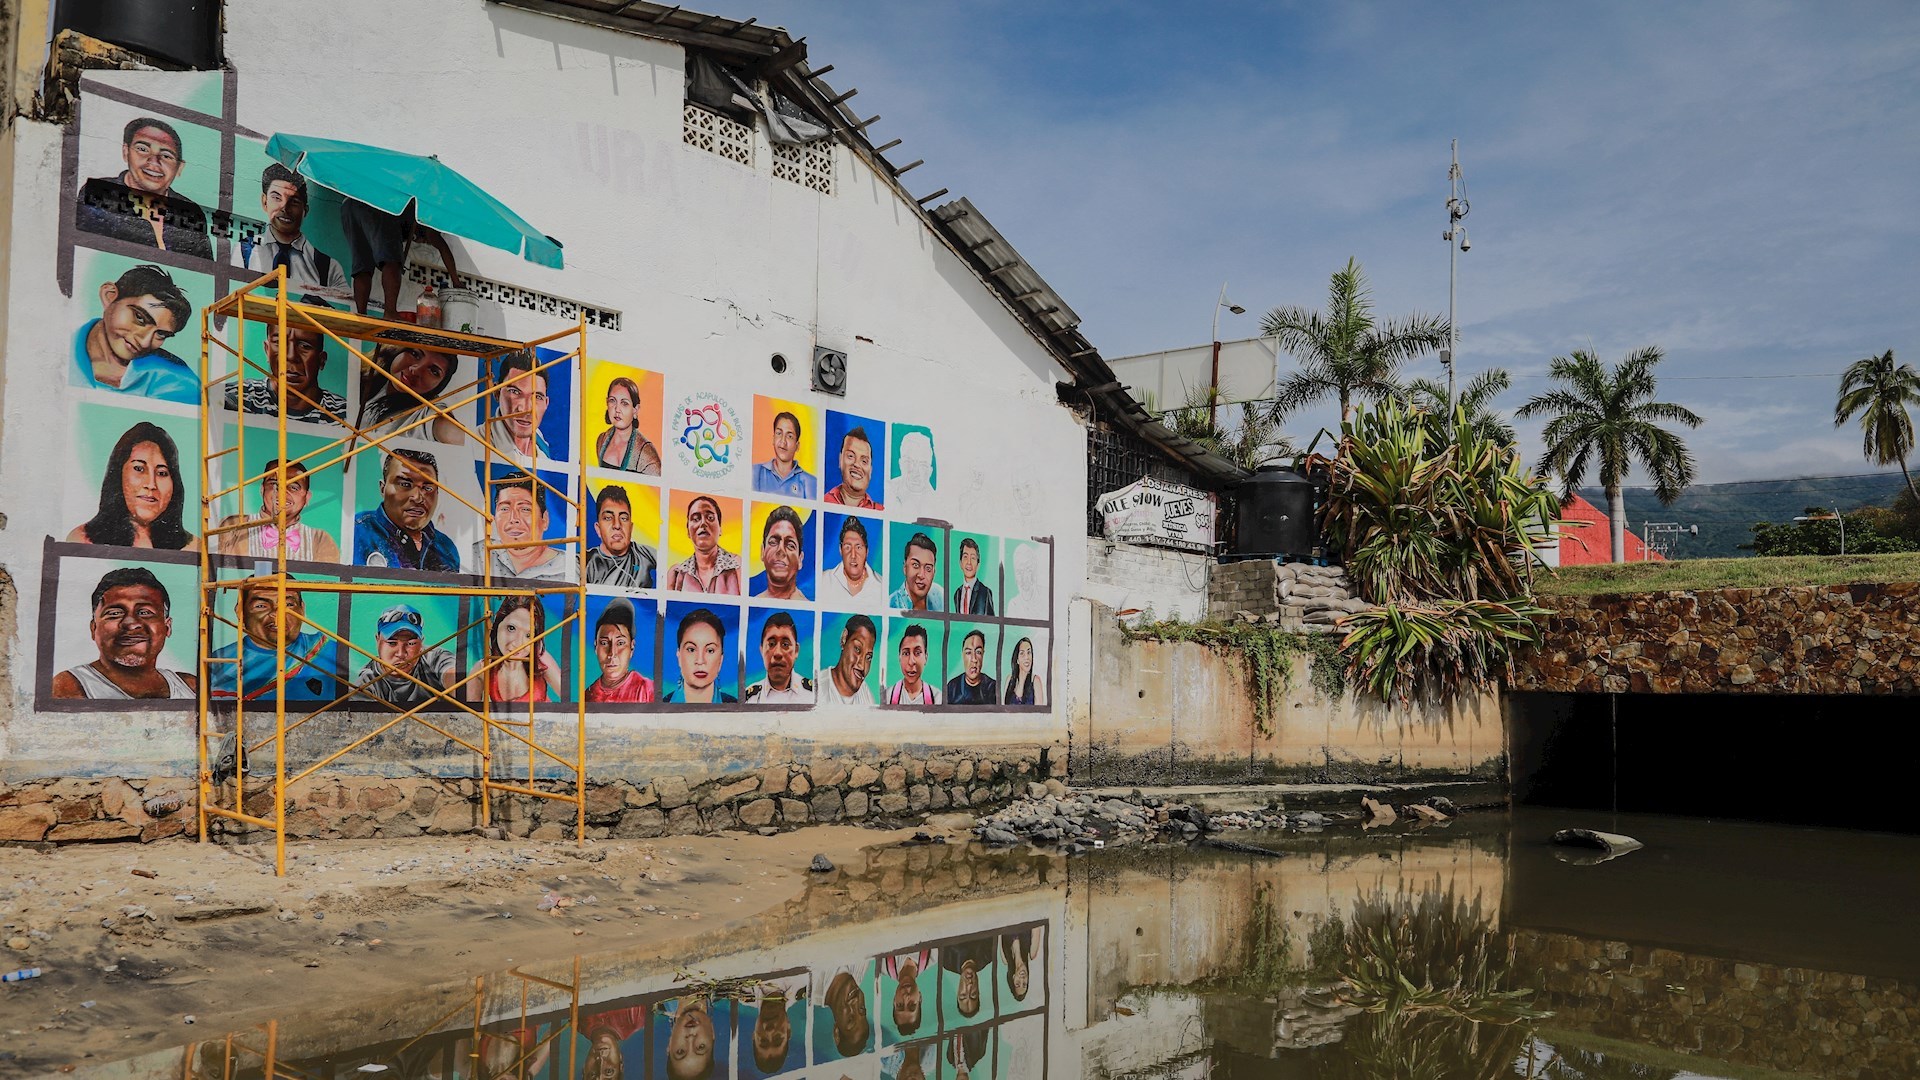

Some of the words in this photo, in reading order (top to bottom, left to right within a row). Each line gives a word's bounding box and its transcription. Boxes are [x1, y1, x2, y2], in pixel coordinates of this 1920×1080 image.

[685, 397, 693, 405] DE
[696, 392, 727, 407] ACAPULCO
[728, 408, 735, 417] EN
[734, 418, 743, 441] BUSCA
[672, 438, 680, 447] DE
[679, 452, 690, 465] SUS
[1164, 498, 1194, 519] JUEVES
